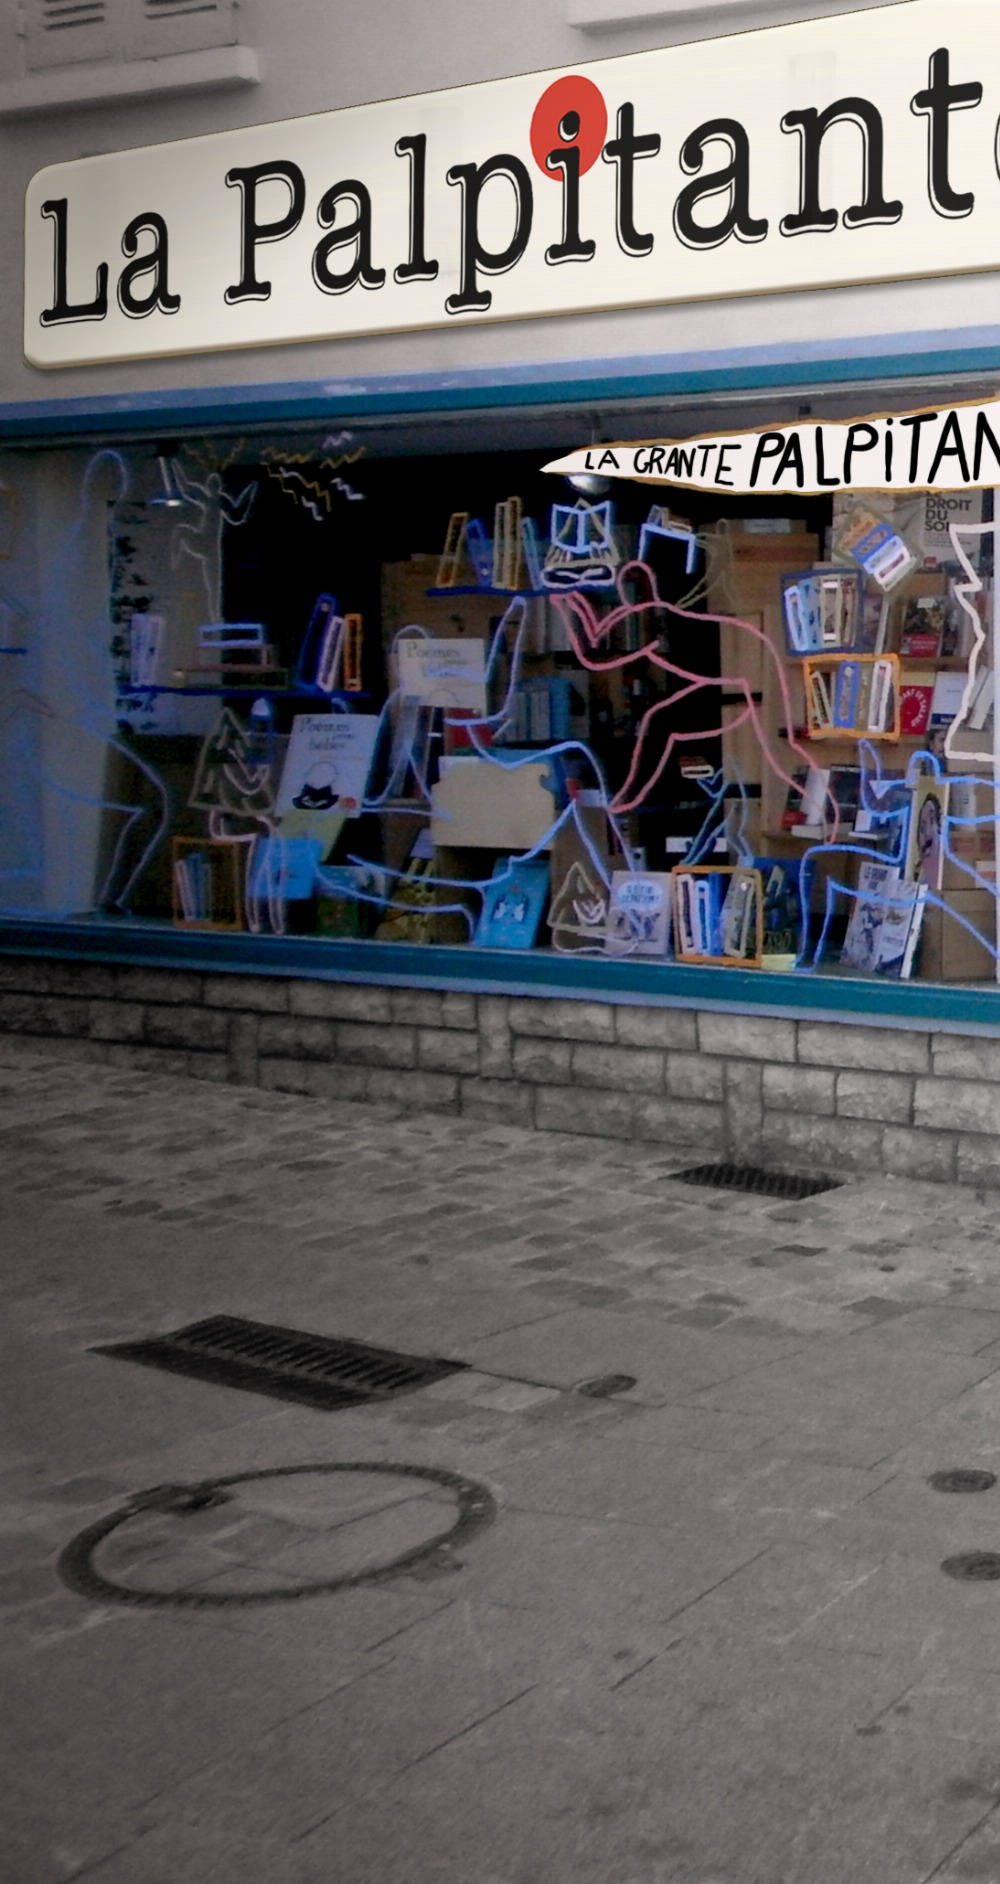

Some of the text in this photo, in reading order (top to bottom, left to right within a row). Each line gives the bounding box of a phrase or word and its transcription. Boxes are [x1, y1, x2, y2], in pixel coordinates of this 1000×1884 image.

[39, 197, 180, 328] La
[584, 448, 620, 470] LA
[633, 443, 742, 486] GRANTE
[925, 497, 972, 510] DROIT
[925, 509, 948, 521] DU
